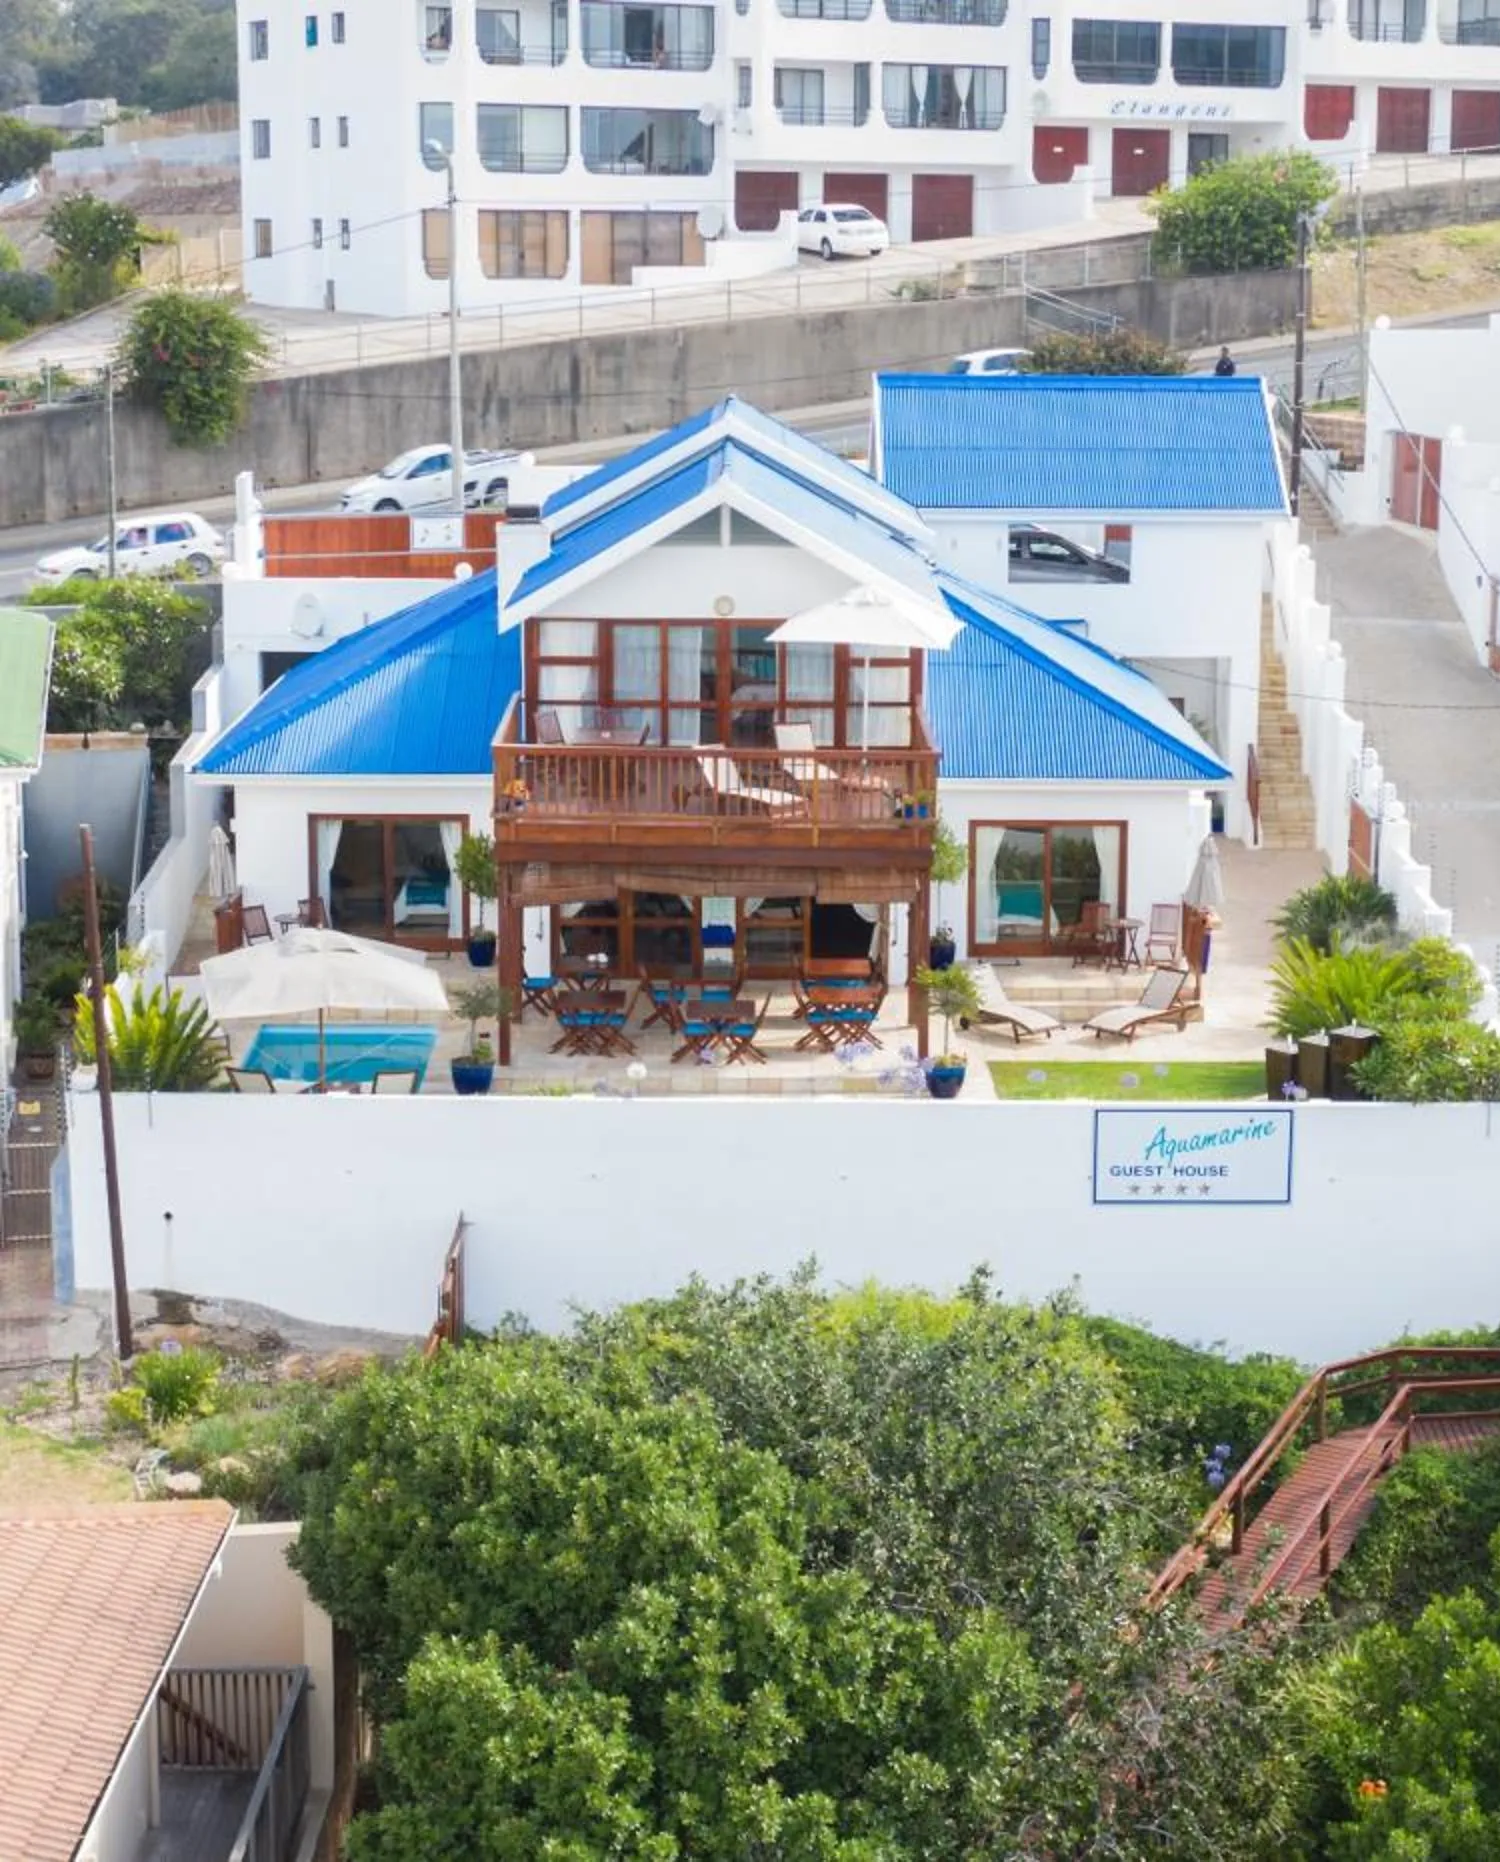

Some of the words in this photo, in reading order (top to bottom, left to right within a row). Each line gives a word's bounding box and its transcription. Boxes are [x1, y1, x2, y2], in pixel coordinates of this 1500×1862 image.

[1145, 1118, 1276, 1168] Aquamarine
[1109, 1164, 1163, 1177] GUEST
[1173, 1164, 1230, 1177] HOUSE
